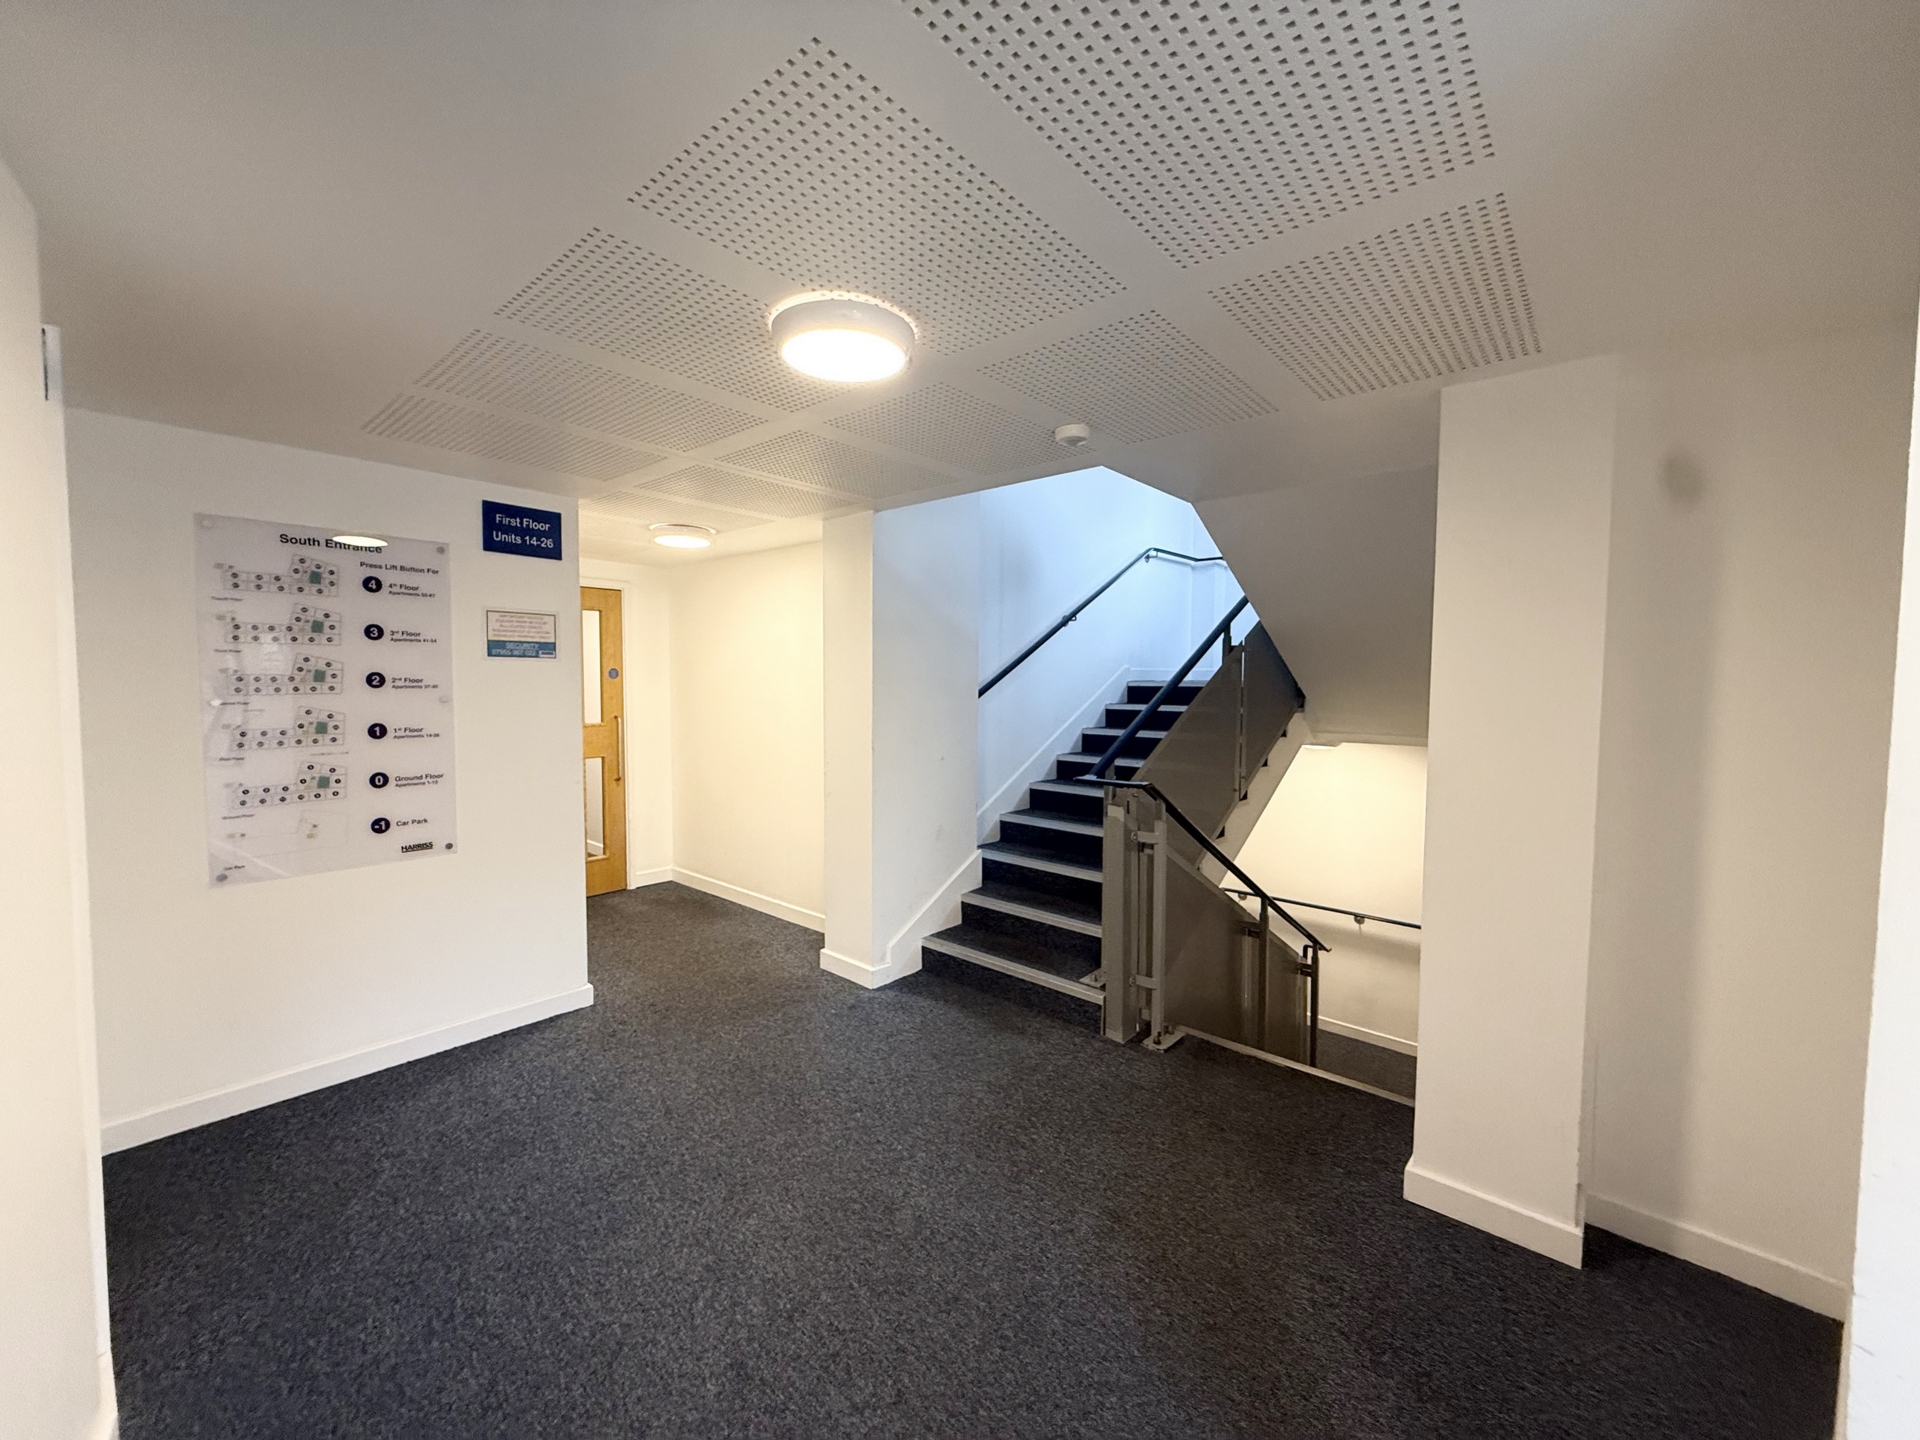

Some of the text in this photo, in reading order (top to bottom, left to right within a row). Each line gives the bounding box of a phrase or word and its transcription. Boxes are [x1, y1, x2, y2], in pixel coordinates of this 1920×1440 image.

[496, 514, 550, 531] First Floor
[279, 534, 320, 547] South
[493, 531, 554, 548] Units 14-26
[360, 561, 382, 569] Press
[400, 565, 425, 573] Button
[368, 580, 376, 589] 4
[370, 627, 378, 637] 3
[371, 675, 380, 685] 2
[373, 726, 380, 736] 1
[375, 775, 383, 786] 0
[374, 820, 386, 830] -1
